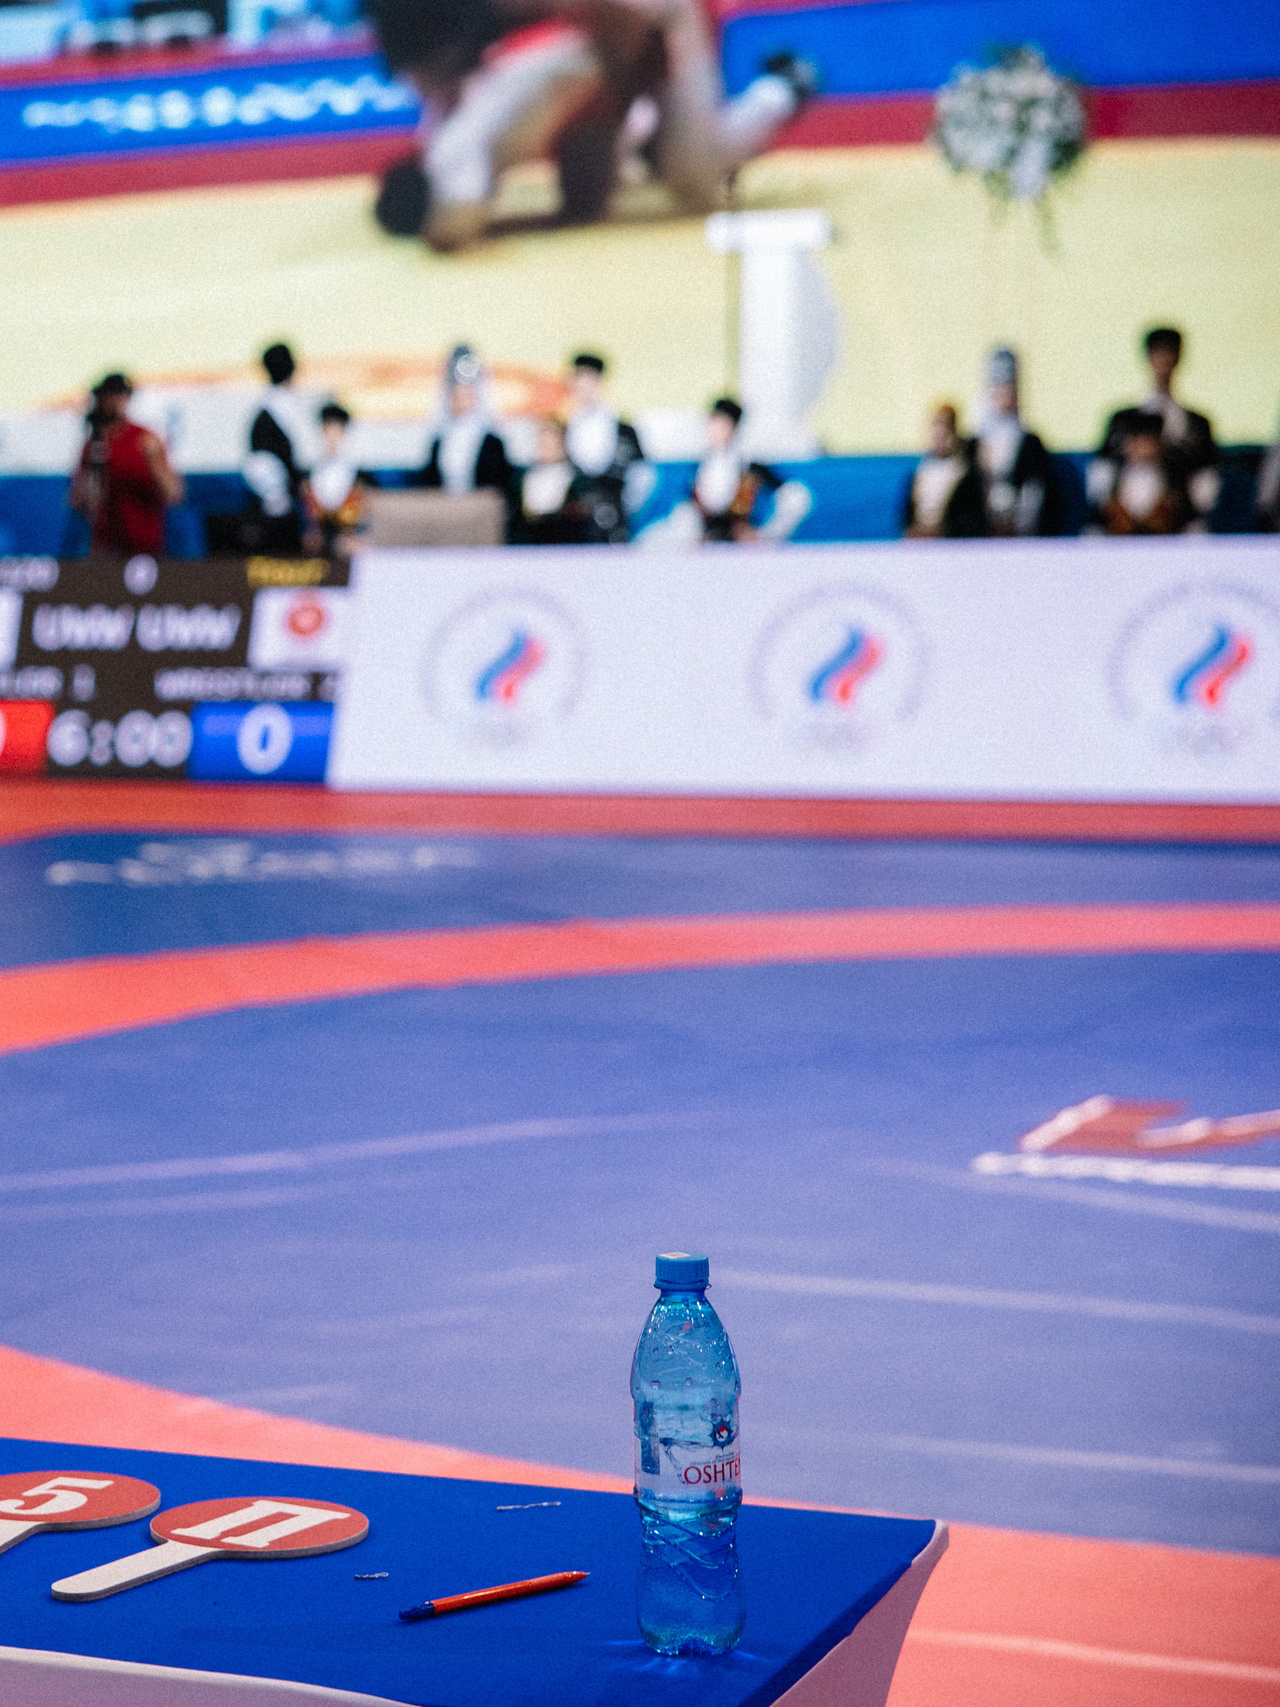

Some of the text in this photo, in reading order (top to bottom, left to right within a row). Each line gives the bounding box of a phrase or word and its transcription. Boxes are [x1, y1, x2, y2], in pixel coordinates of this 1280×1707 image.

[123, 553, 159, 595] 0
[32, 603, 243, 652] UWW UWW
[154, 666, 311, 700] WRESTLER
[47, 708, 194, 768] 6:00
[236, 702, 293, 775] 0
[684, 1457, 740, 1485] OSHTE
